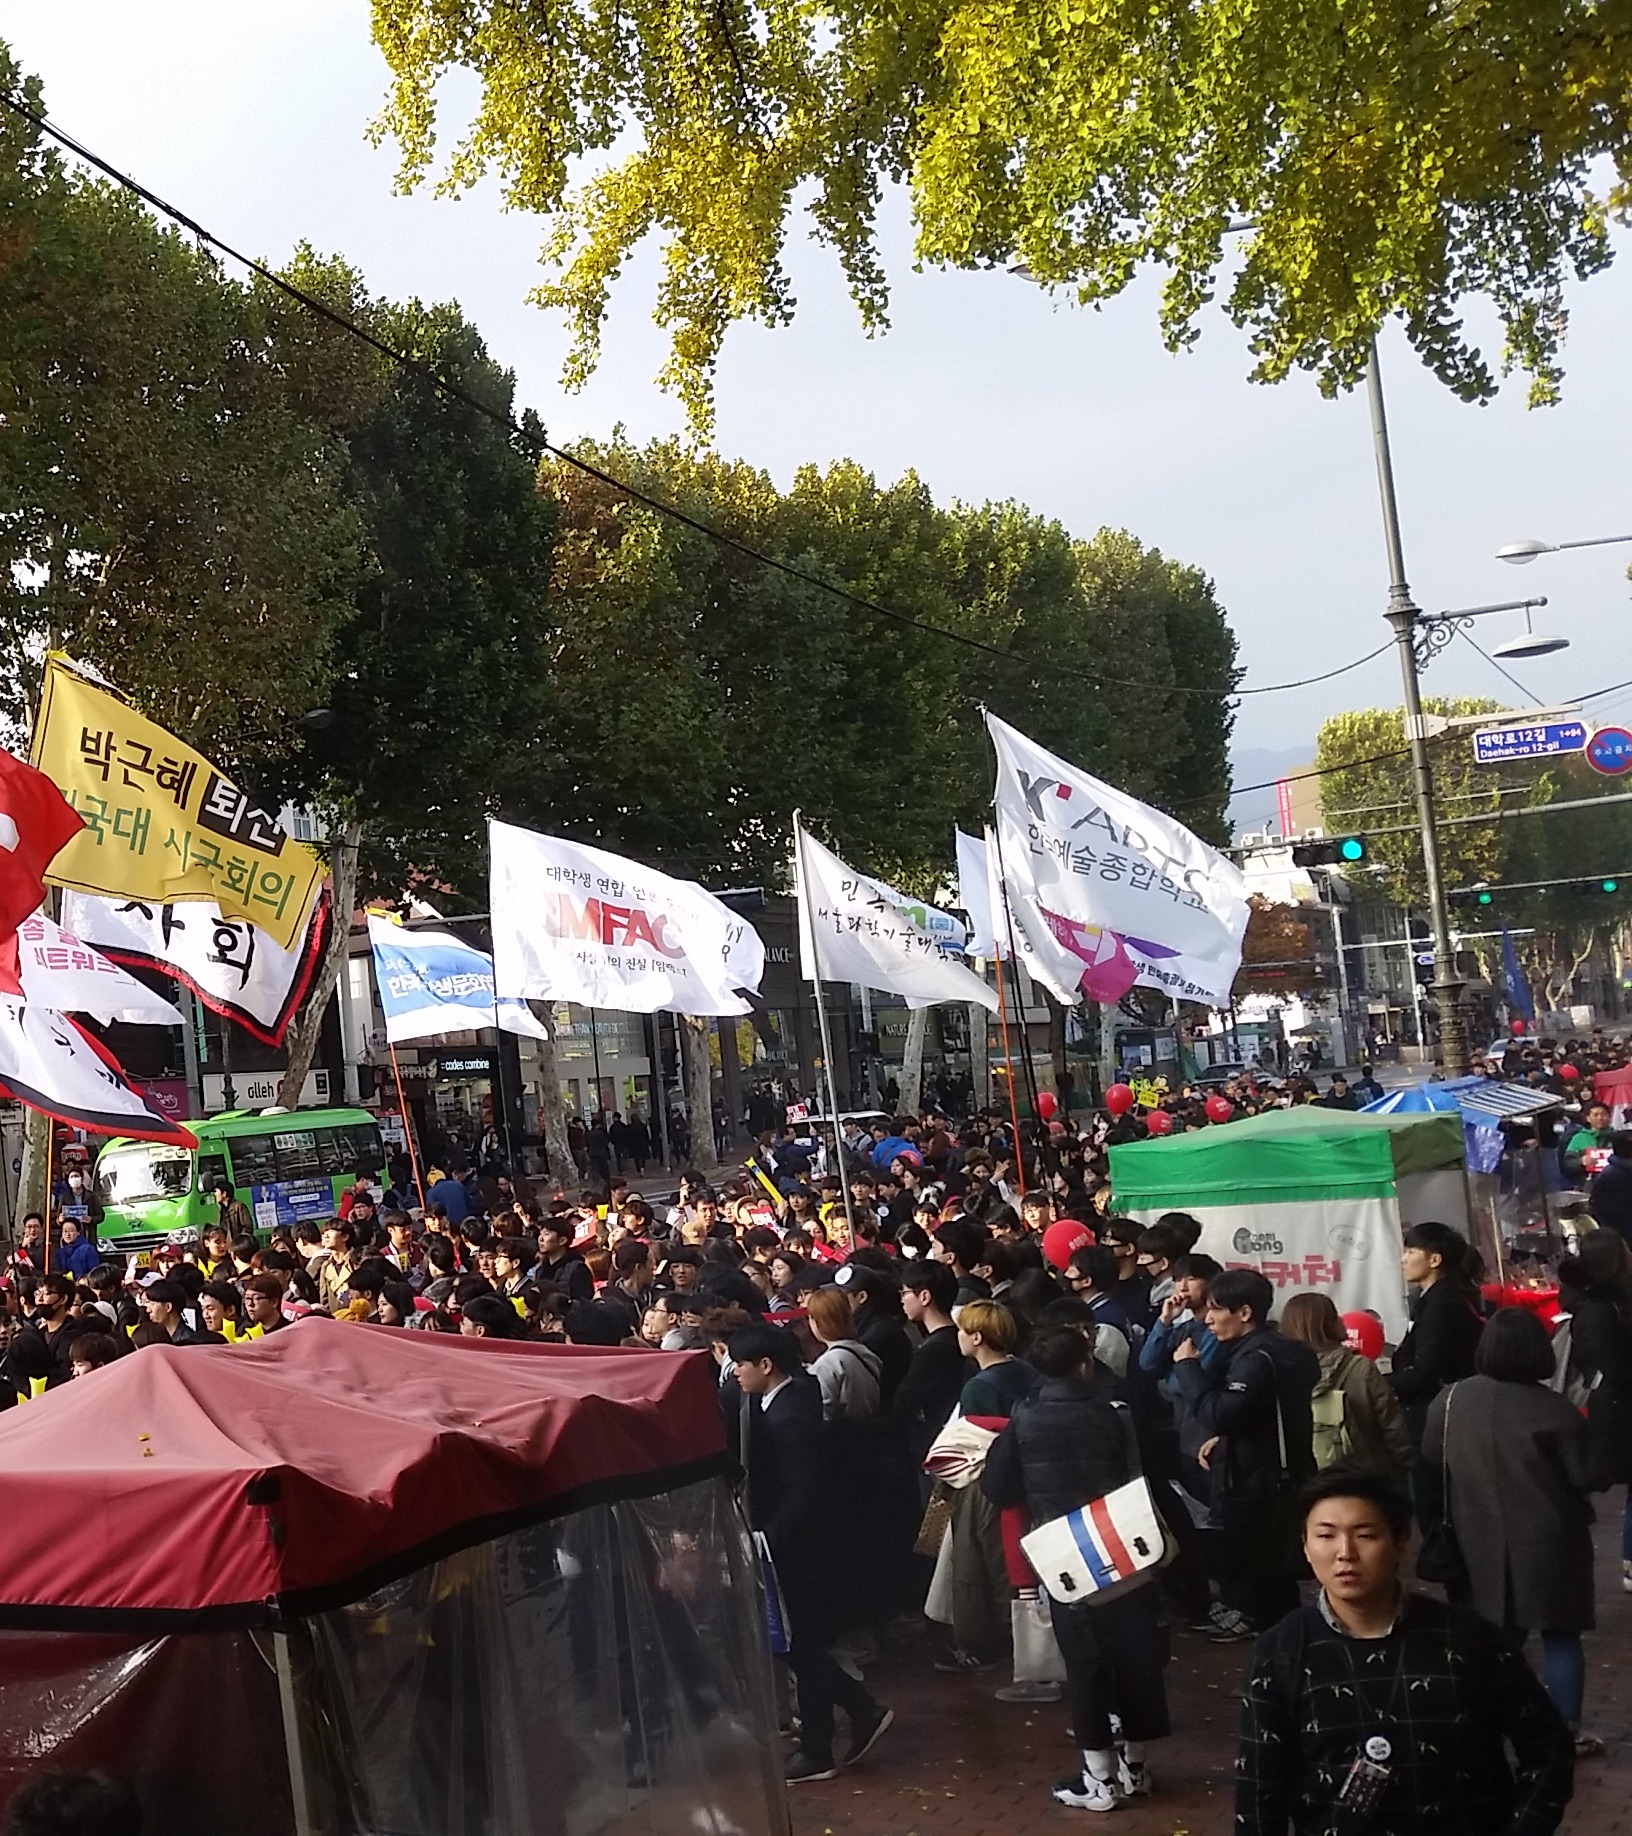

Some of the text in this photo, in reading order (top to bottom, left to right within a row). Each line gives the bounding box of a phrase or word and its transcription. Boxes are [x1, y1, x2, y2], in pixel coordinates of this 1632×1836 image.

[1478, 728, 1547, 748] 대학로12길
[1479, 740, 1560, 759] Daehak-ro 12-gil
[79, 725, 198, 811] 박근혜
[163, 827, 296, 921] 시국회의
[545, 866, 592, 889] 대학생
[596, 877, 626, 898] 연합
[625, 957, 647, 972] 진실
[763, 947, 791, 963] ALANCE
[445, 1057, 490, 1071] codes combine
[247, 1081, 275, 1099] olleh
